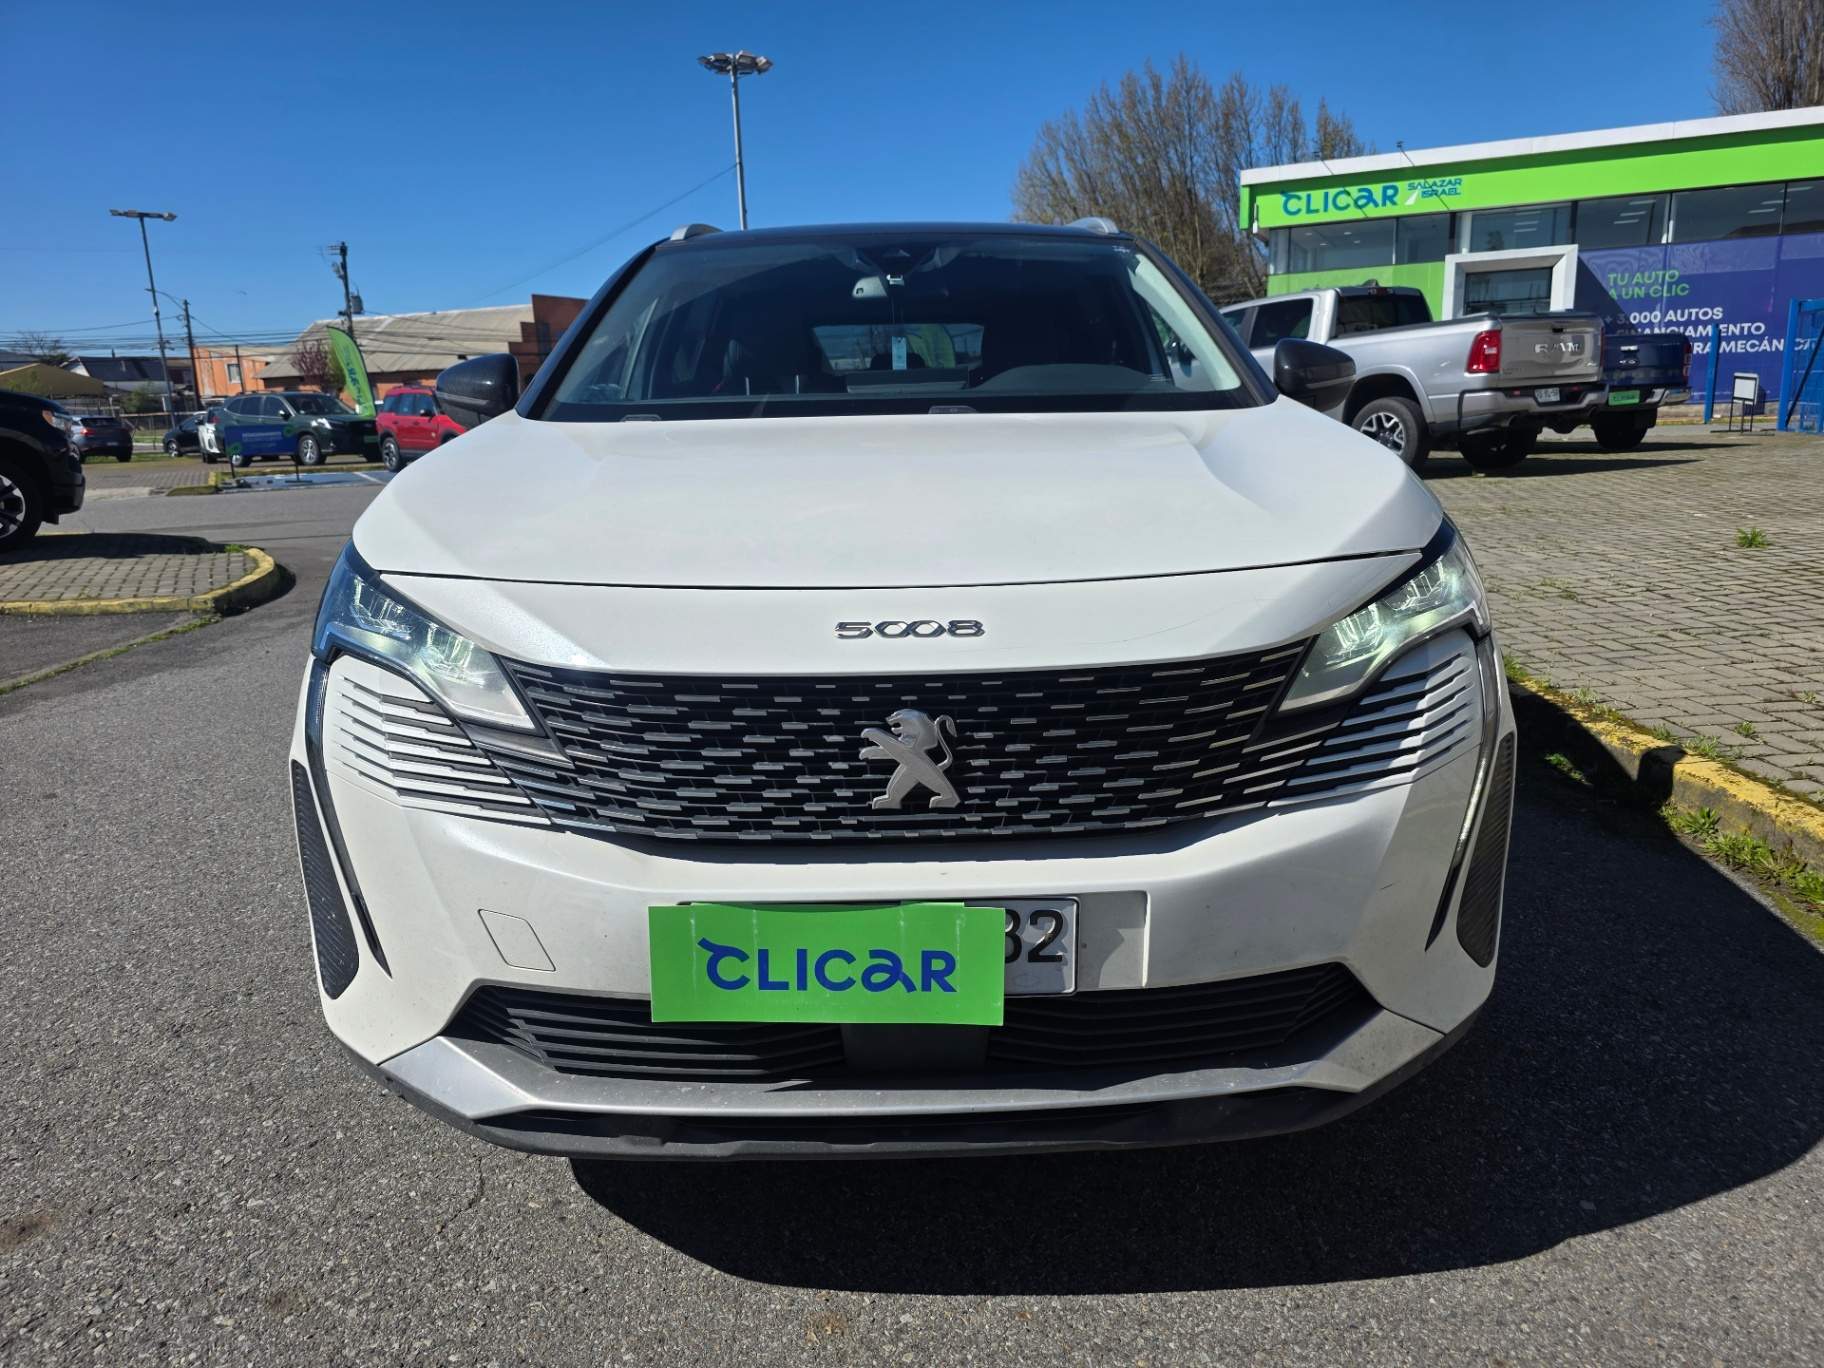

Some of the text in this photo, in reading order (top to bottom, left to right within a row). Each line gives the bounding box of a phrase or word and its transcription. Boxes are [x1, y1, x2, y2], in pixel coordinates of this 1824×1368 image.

[1407, 178, 1462, 191] SALAZAR
[1421, 187, 1461, 199] ISRAEL
[1608, 269, 1680, 286] TU AUTO
[1622, 286, 1646, 299] UN
[1649, 283, 1690, 298] CLIC
[1616, 311, 1661, 325] 3.000
[1664, 306, 1723, 322] AUTOS
[835, 619, 985, 639] 5008
